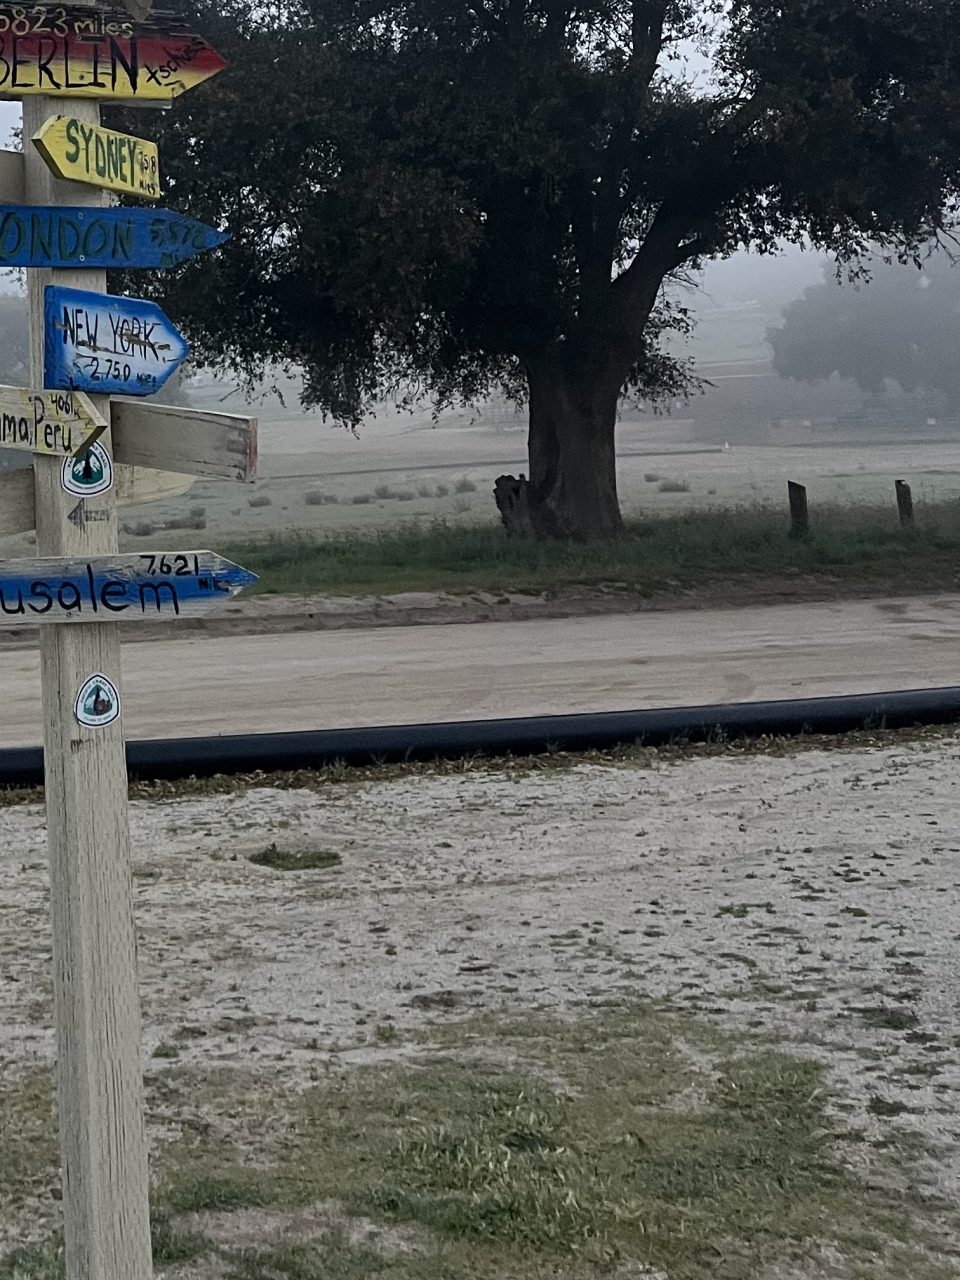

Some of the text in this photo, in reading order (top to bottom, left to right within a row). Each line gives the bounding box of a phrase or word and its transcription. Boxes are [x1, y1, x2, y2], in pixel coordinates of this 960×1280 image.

[74, 12, 135, 38] miles
[65, 118, 137, 188] SYDNEY
[63, 306, 159, 361] NEW YORK
[34, 396, 72, 453] Peru
